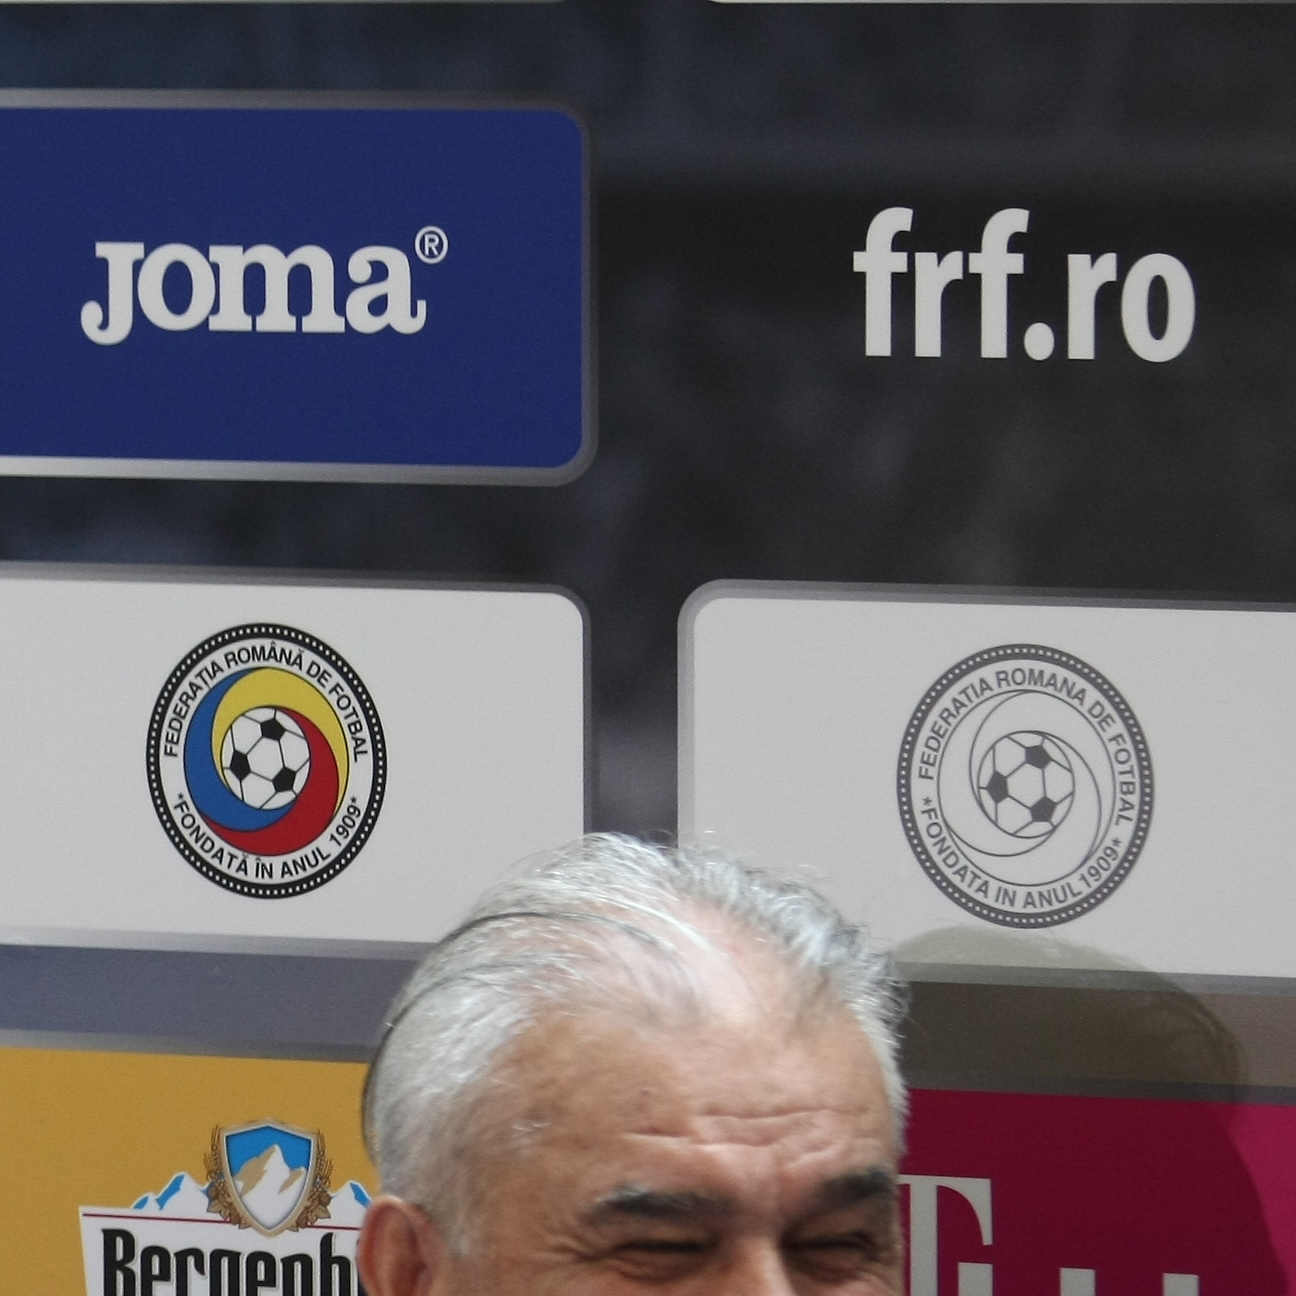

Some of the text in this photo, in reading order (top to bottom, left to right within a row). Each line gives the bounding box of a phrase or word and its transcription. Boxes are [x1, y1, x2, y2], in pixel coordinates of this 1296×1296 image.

[853, 207, 1196, 362] frf.ro
[306, 661, 332, 688] DE
[329, 685, 368, 762] FOTBAL
[995, 668, 1088, 706] ROMANA
[1087, 700, 1117, 732] DE
[1109, 733, 1137, 826] FOTBAL
[280, 846, 331, 879] ANUL
[329, 803, 361, 847] 1909
[994, 886, 1015, 908] IN
[1022, 884, 1082, 909] ANUL
[1079, 846, 1119, 889] 1909
